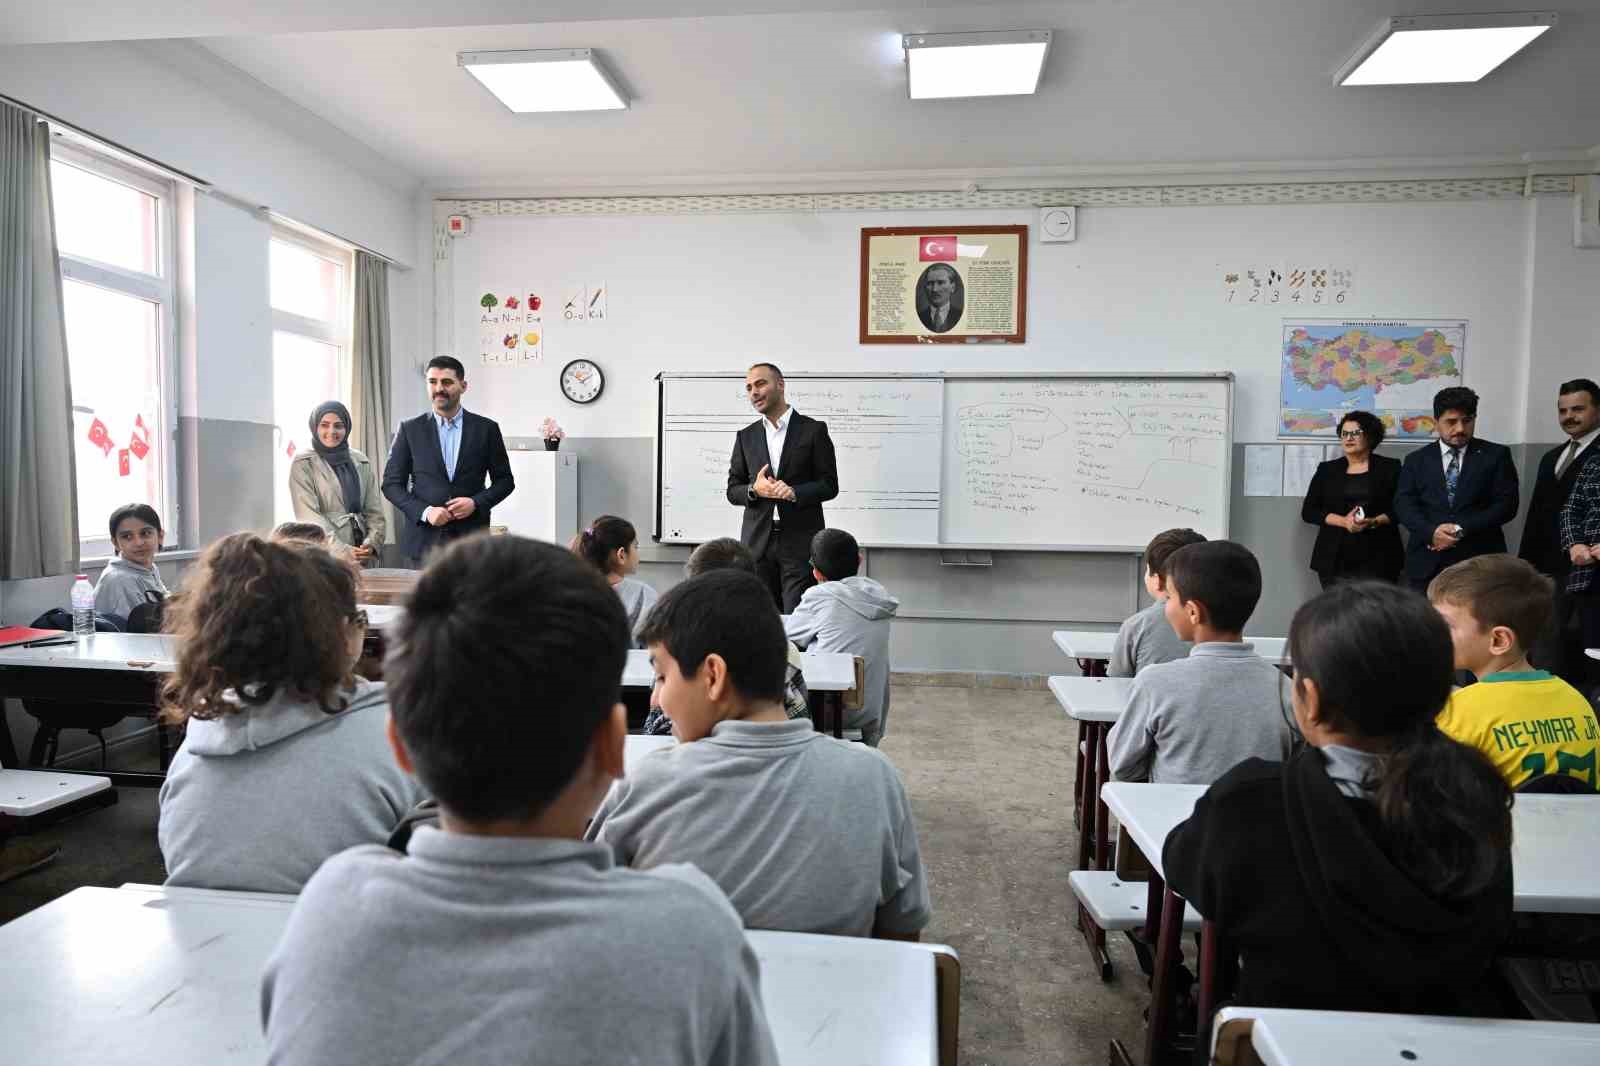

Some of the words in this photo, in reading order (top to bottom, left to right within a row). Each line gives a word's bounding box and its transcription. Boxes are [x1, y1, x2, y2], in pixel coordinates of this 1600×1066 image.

[1225, 290, 1236, 302] 1
[1248, 289, 1260, 302] 2
[1271, 290, 1280, 303] 3
[1291, 290, 1301, 303] 4
[1312, 290, 1323, 304] 5
[1336, 290, 1346, 304] 6
[1493, 717, 1580, 752] NEYMAR
